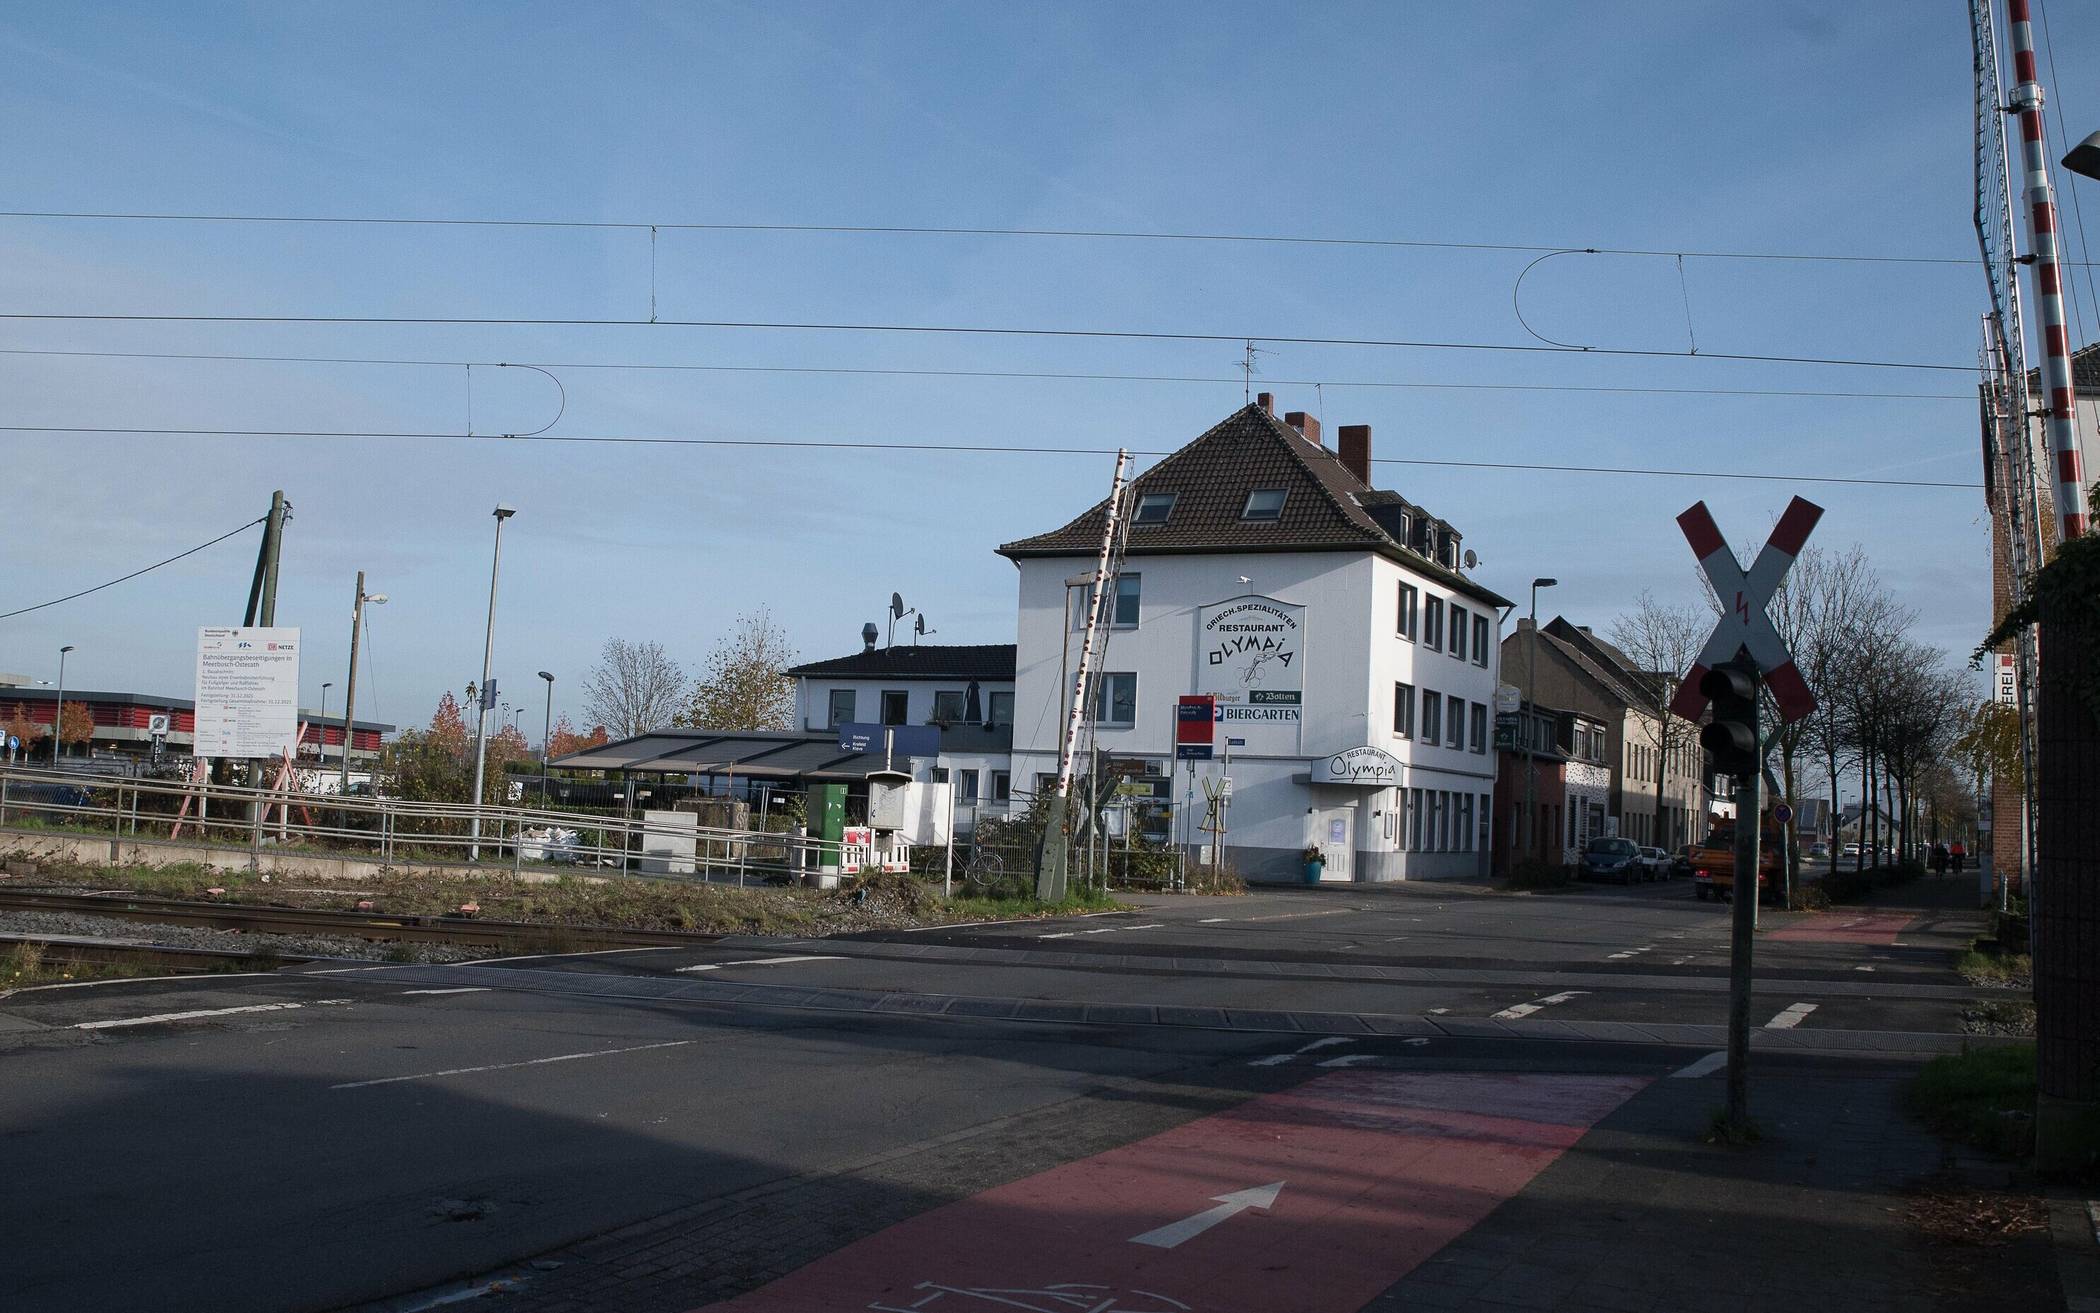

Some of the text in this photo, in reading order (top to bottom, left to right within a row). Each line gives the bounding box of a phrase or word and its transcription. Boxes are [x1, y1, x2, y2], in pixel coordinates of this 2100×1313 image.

[1219, 624, 1285, 632] RESTAURANT
[2002, 672, 2013, 706] EREI
[1226, 709, 1299, 720] BIERGARTEN
[1346, 749, 1386, 760] RESTAURANT
[1330, 756, 1396, 783] Olympia
